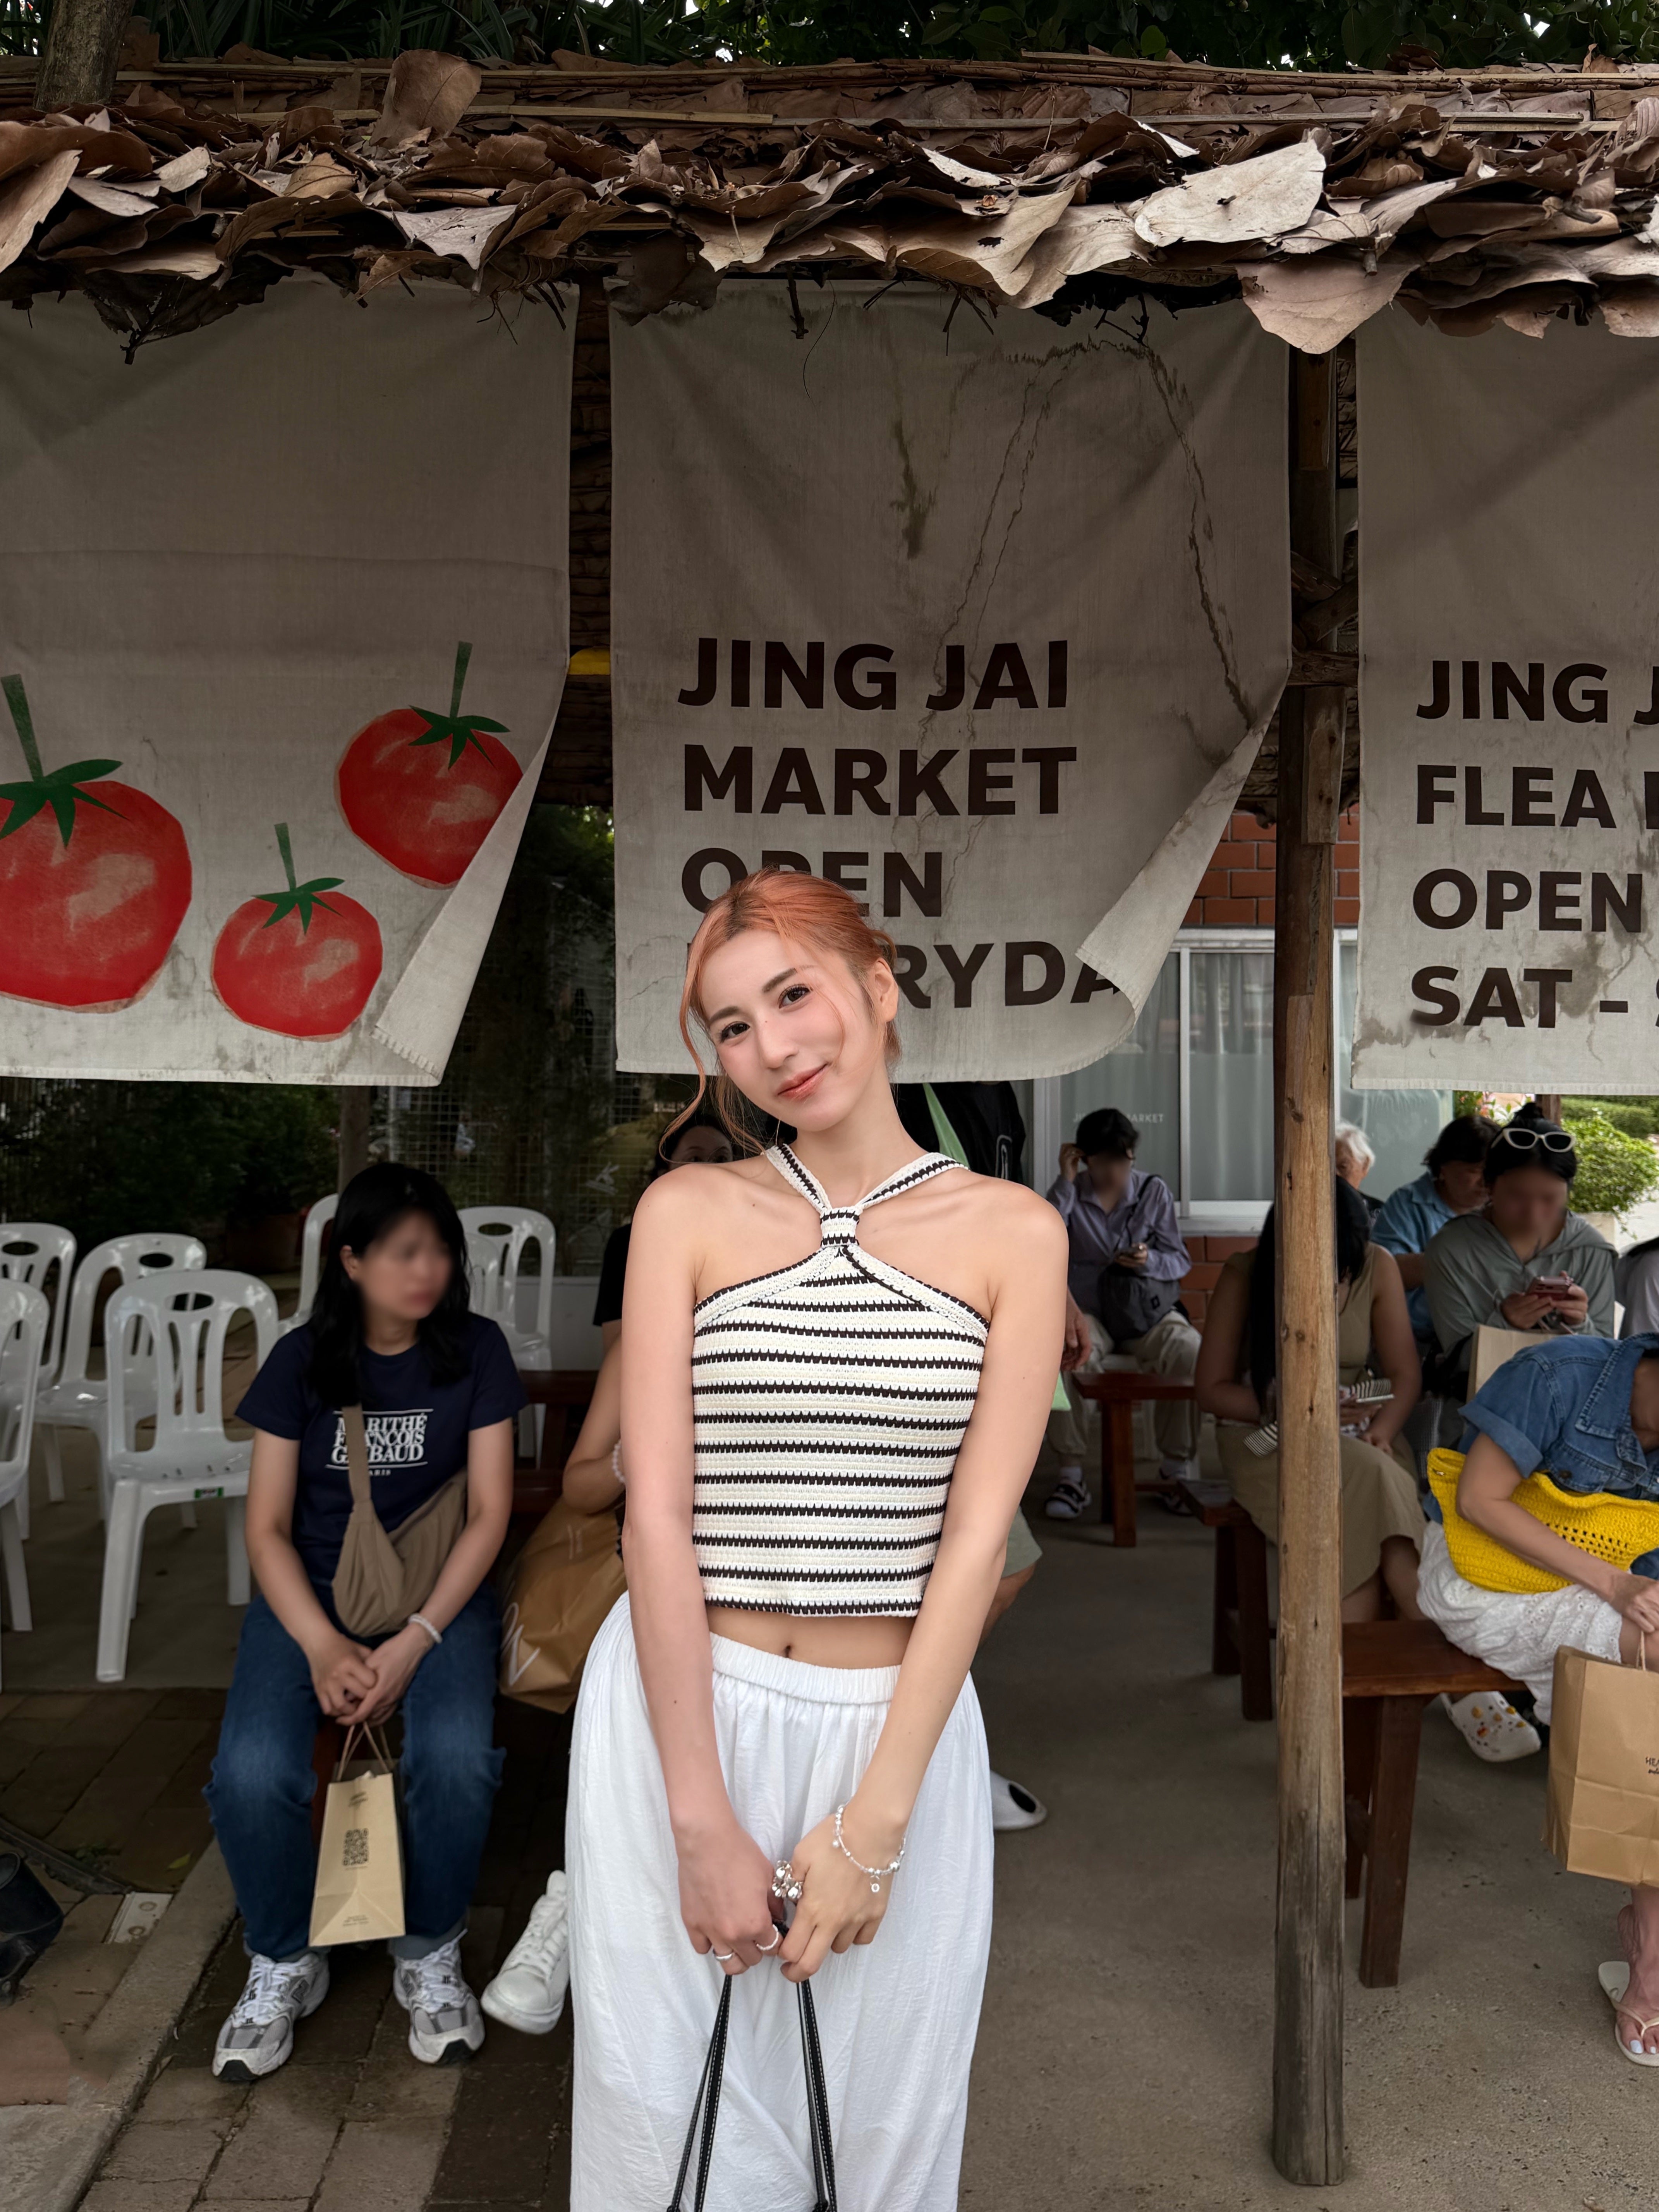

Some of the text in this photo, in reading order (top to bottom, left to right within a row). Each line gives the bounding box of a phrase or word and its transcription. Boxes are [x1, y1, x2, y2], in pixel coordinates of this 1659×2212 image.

[677, 637, 1068, 711] JING JAI
[1416, 660, 1608, 723] JING
[684, 744, 1077, 816] MARKET
[1416, 764, 1617, 829] FLEA
[1412, 868, 1643, 933] OPEN
[1410, 965, 1573, 1029] SAT
[331, 1443, 424, 1465] GBAUD
